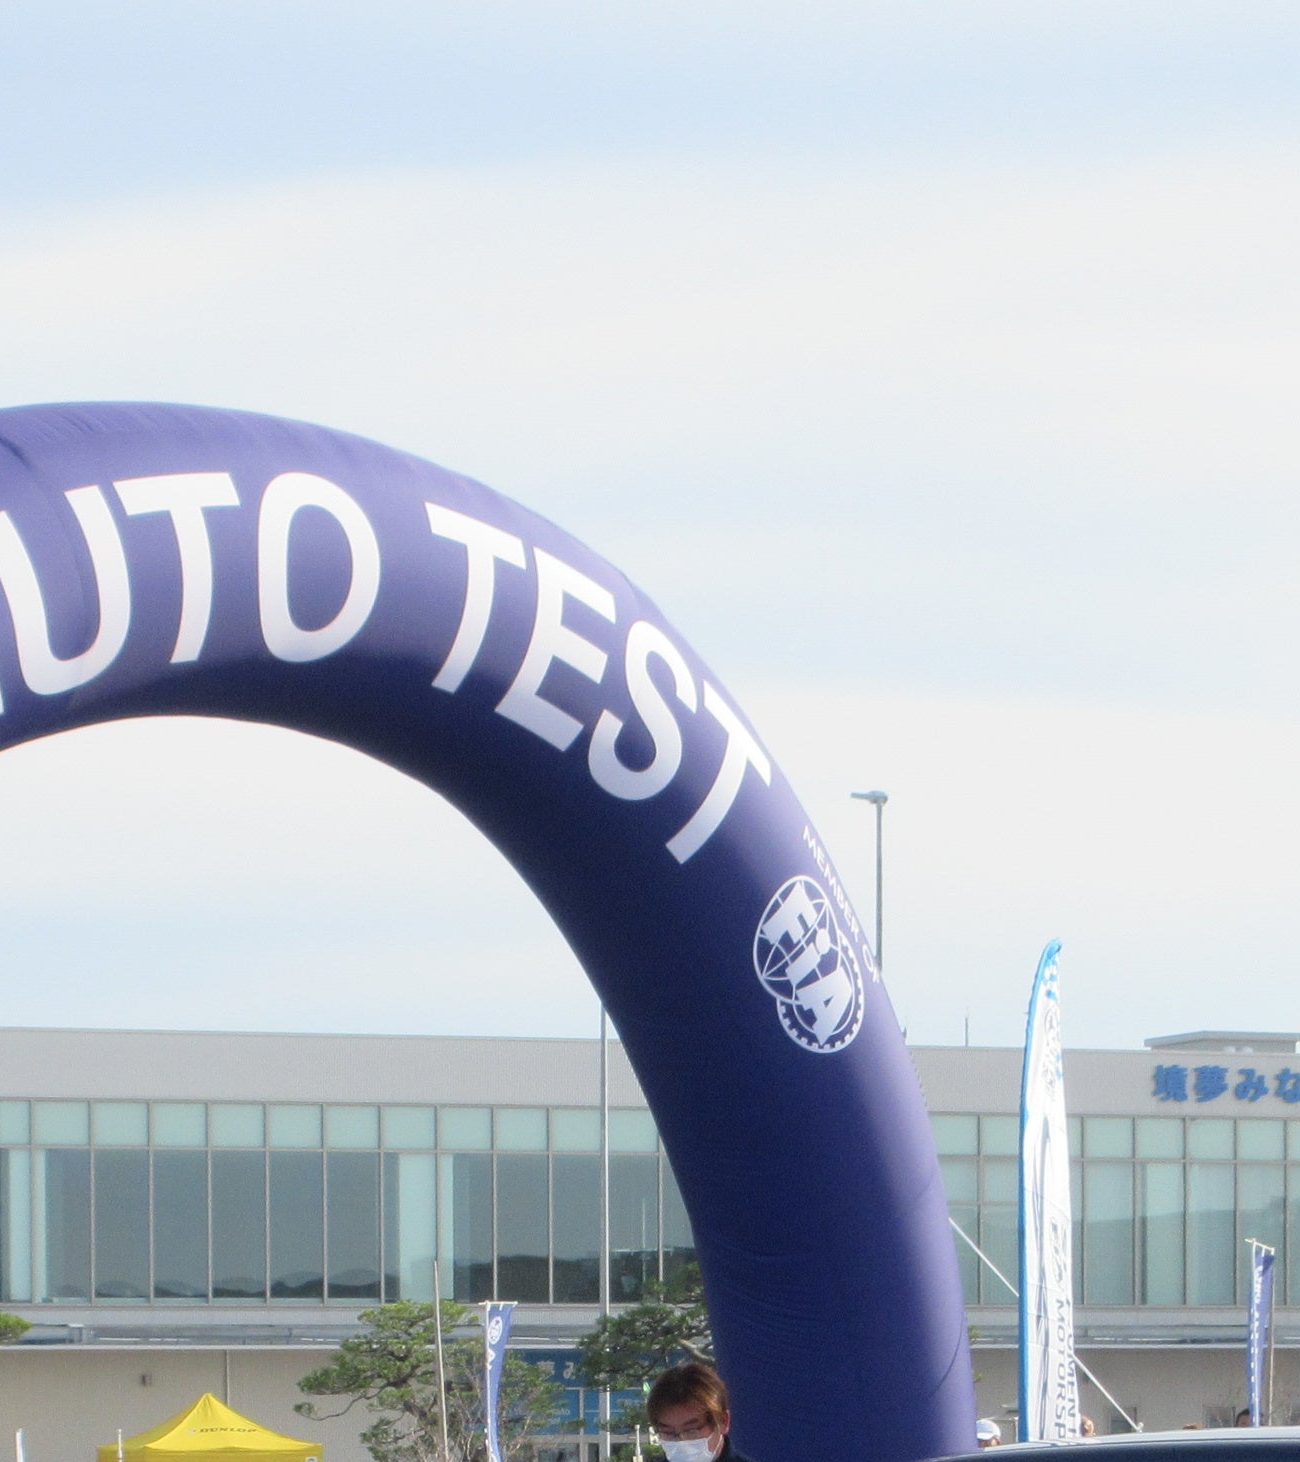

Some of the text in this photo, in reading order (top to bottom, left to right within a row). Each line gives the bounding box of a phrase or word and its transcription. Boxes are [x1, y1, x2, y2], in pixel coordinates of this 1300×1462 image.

[424, 500, 771, 865] TEST
[761, 880, 853, 1047] FIA
[802, 825, 860, 942] MEMBER
